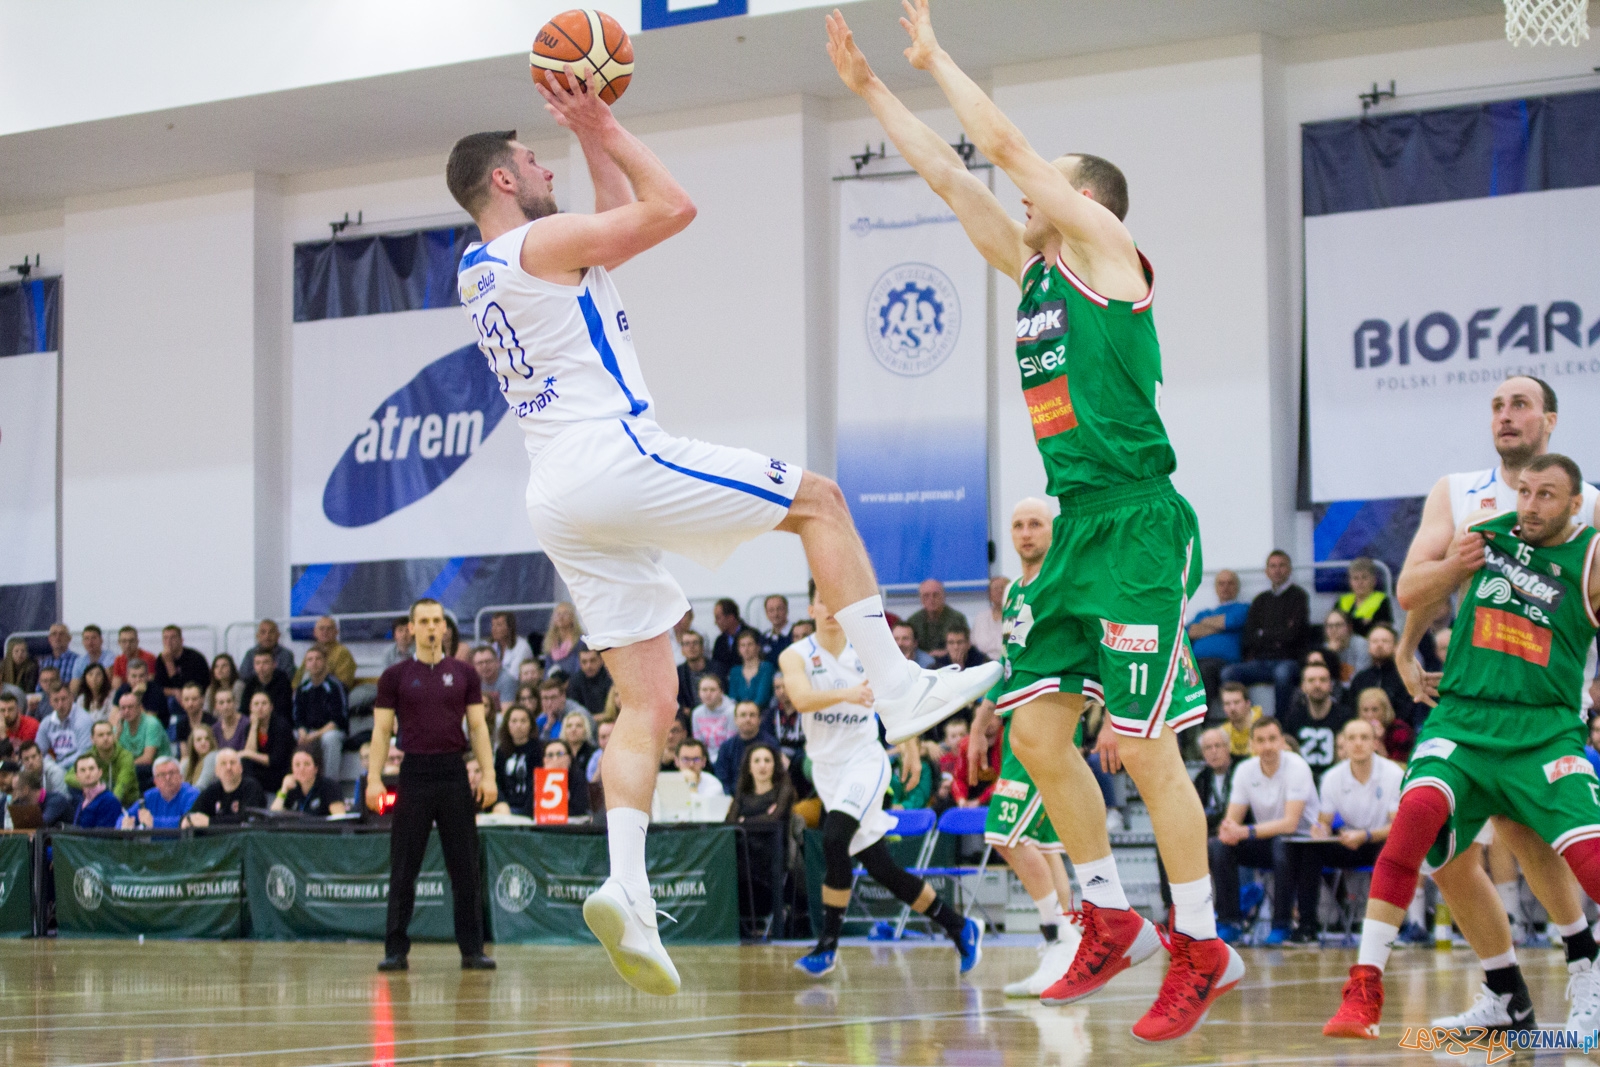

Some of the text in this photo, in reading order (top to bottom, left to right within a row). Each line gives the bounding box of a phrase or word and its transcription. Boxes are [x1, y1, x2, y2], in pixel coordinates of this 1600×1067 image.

[1354, 301, 1600, 369] BIOFAR
[1555, 360, 1600, 376] LEKÓ
[355, 405, 484, 464] atrem
[1516, 543, 1534, 566] 15
[1128, 662, 1148, 695] 11
[1299, 726, 1334, 765] 23
[540, 772, 565, 809] 5
[998, 801, 1019, 823] 33
[111, 880, 240, 898] POLITECHNIKA POZNAŃSK
[306, 883, 379, 898] POLITECHNIKA
